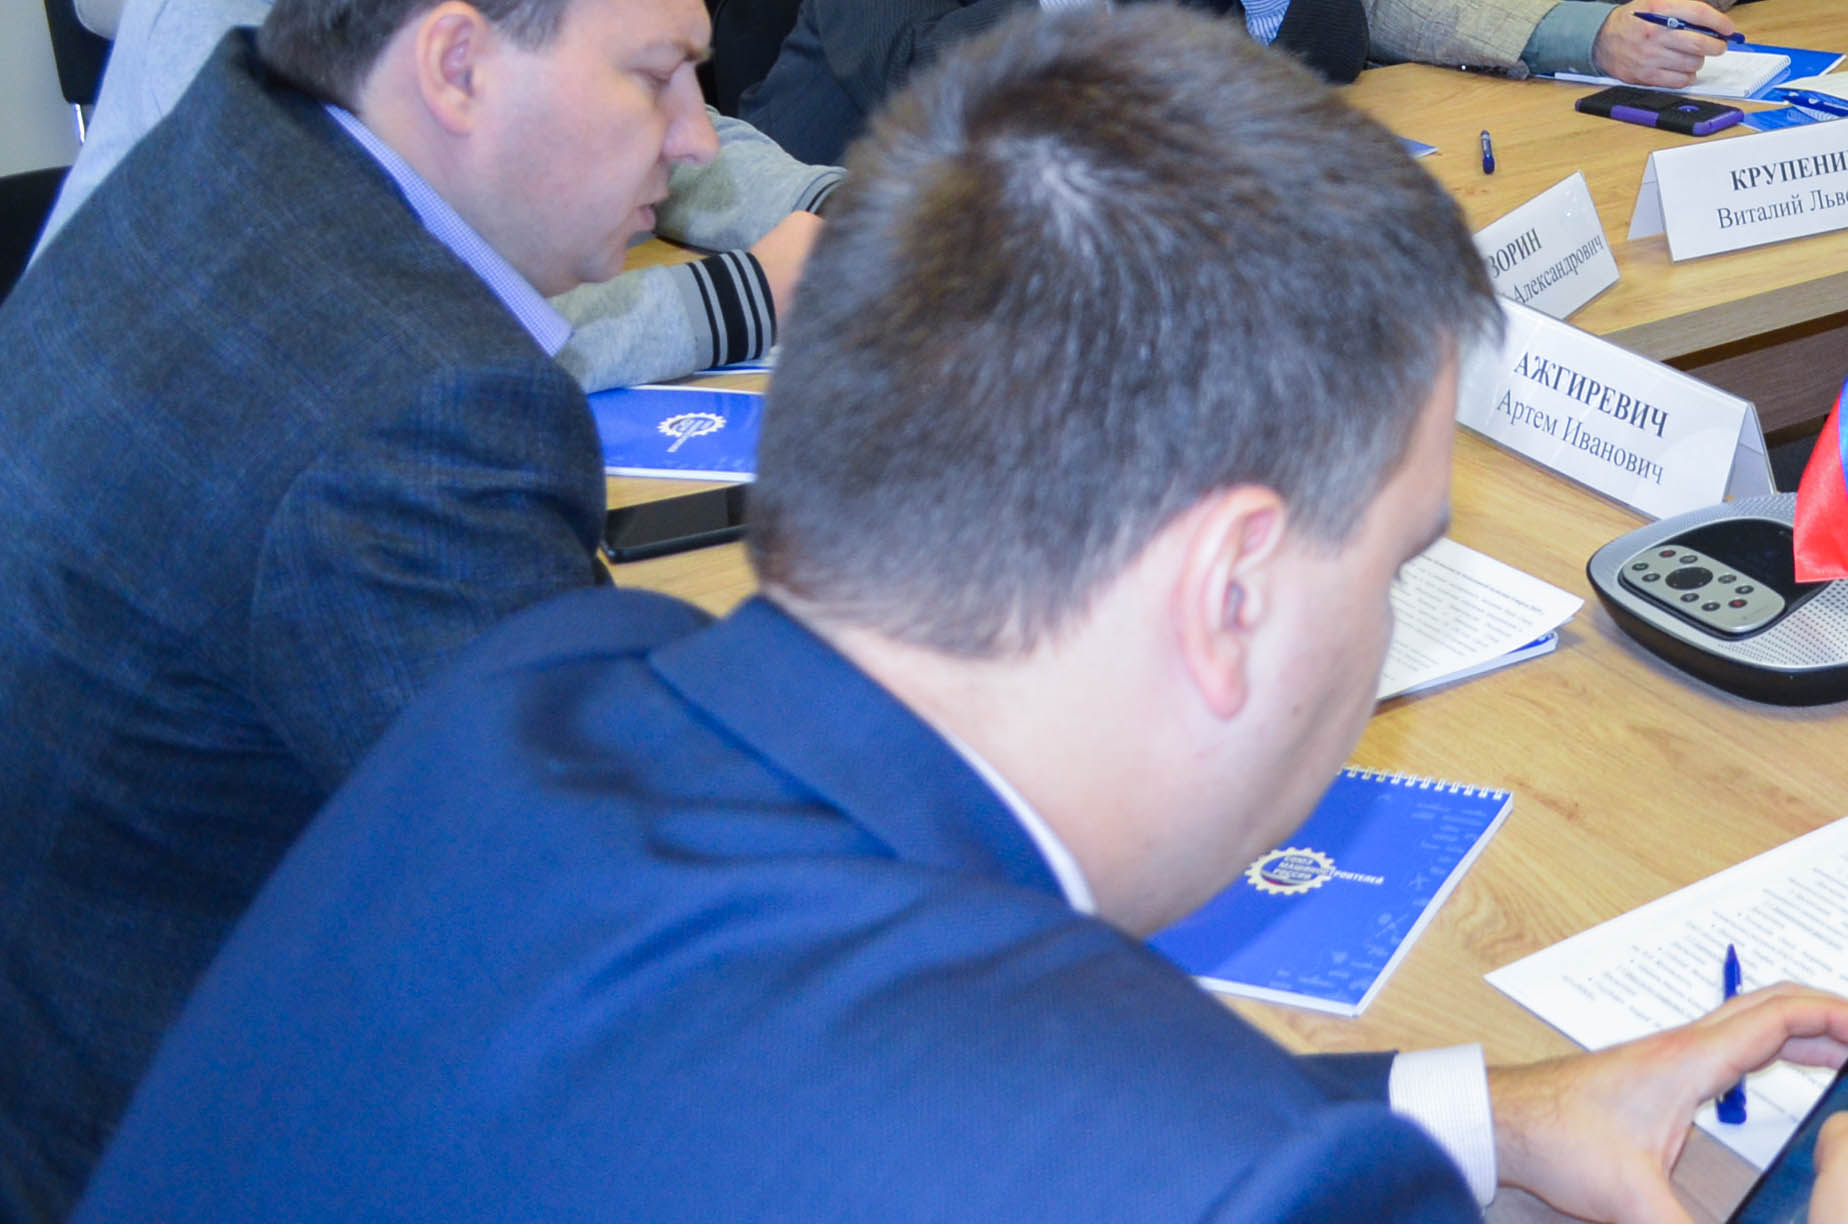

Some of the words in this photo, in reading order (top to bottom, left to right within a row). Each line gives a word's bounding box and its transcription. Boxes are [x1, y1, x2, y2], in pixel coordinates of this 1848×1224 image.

[1716, 193, 1805, 230] Виталий
[1513, 234, 1604, 304] Александрович
[1513, 351, 1671, 439] АЖГИРЕВИЧ
[1496, 388, 1559, 437] Артем
[1561, 415, 1665, 486] Иванович
